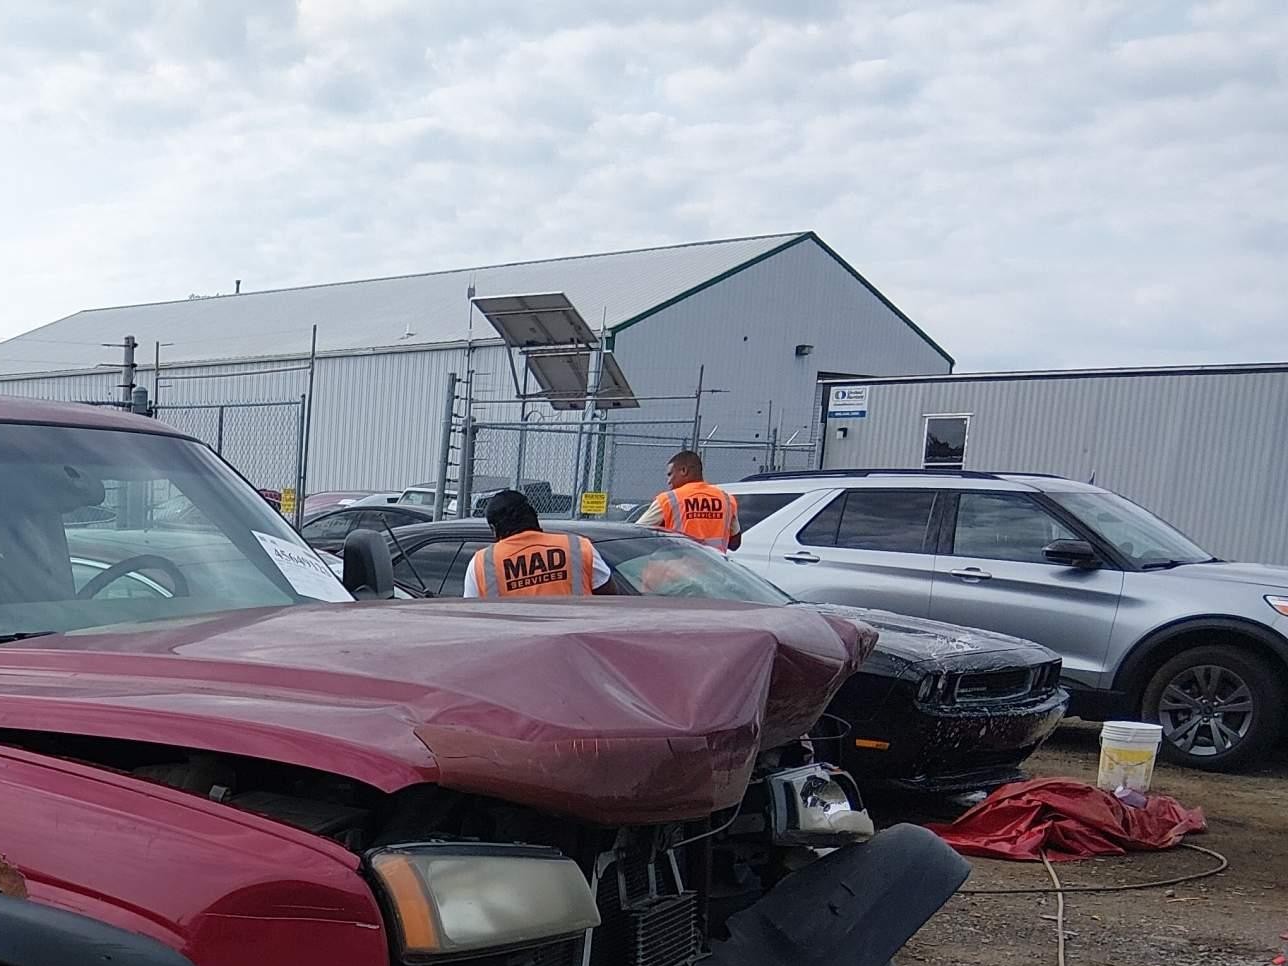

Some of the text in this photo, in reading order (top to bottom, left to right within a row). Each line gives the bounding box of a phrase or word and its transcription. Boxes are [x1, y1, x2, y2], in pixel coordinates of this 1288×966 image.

[684, 498, 722, 512] MAD
[502, 548, 567, 581] MAD
[509, 572, 564, 590] SERVICES
